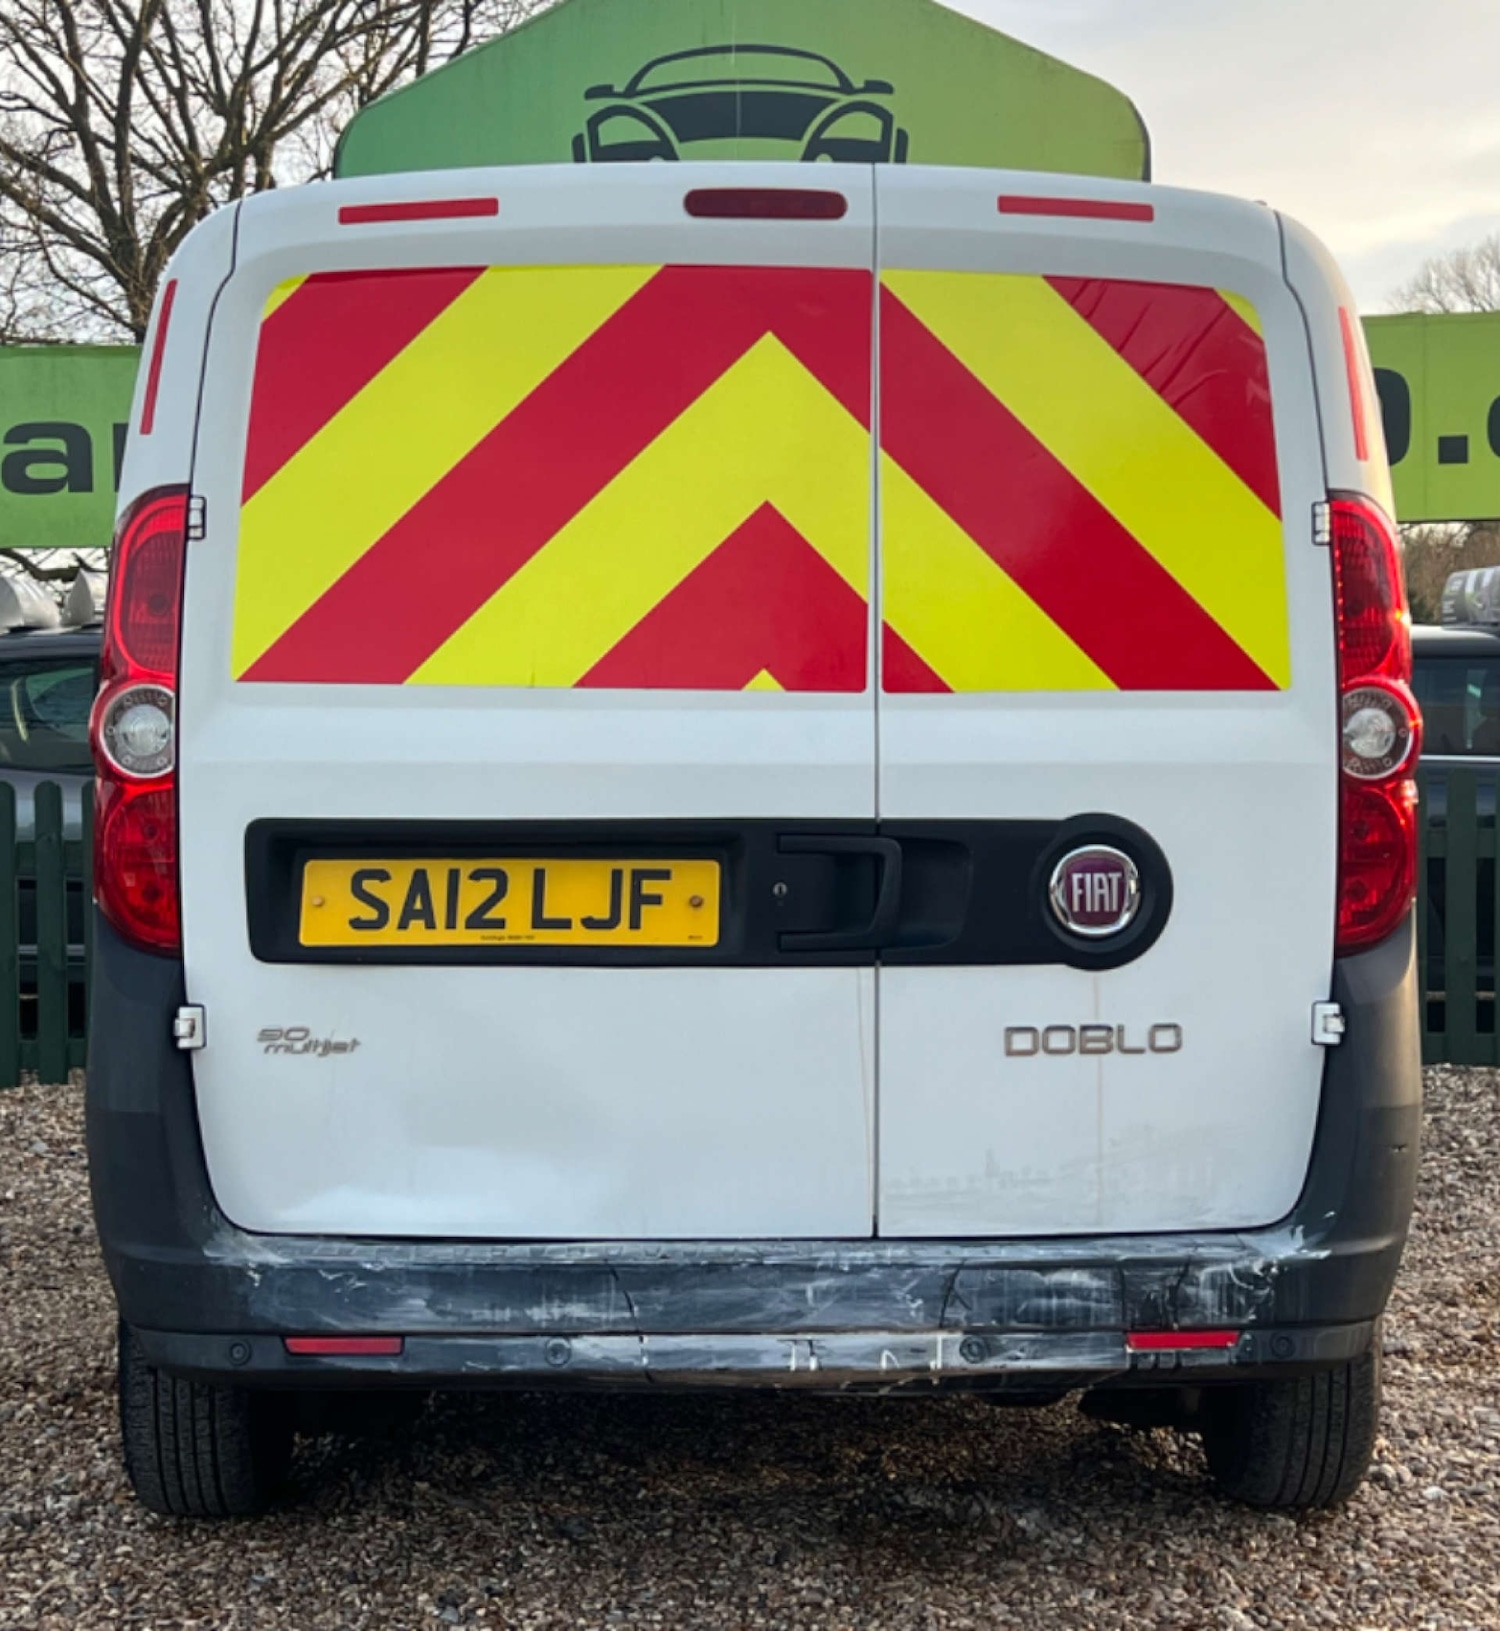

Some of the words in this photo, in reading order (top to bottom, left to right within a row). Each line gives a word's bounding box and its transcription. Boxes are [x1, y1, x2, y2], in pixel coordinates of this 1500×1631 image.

[2, 421, 128, 496] a
[349, 868, 509, 930] SA12
[531, 867, 671, 930] LJF
[1071, 872, 1122, 912] FIAT
[257, 1027, 310, 1042] 90
[1004, 1023, 1183, 1056] DOBLO
